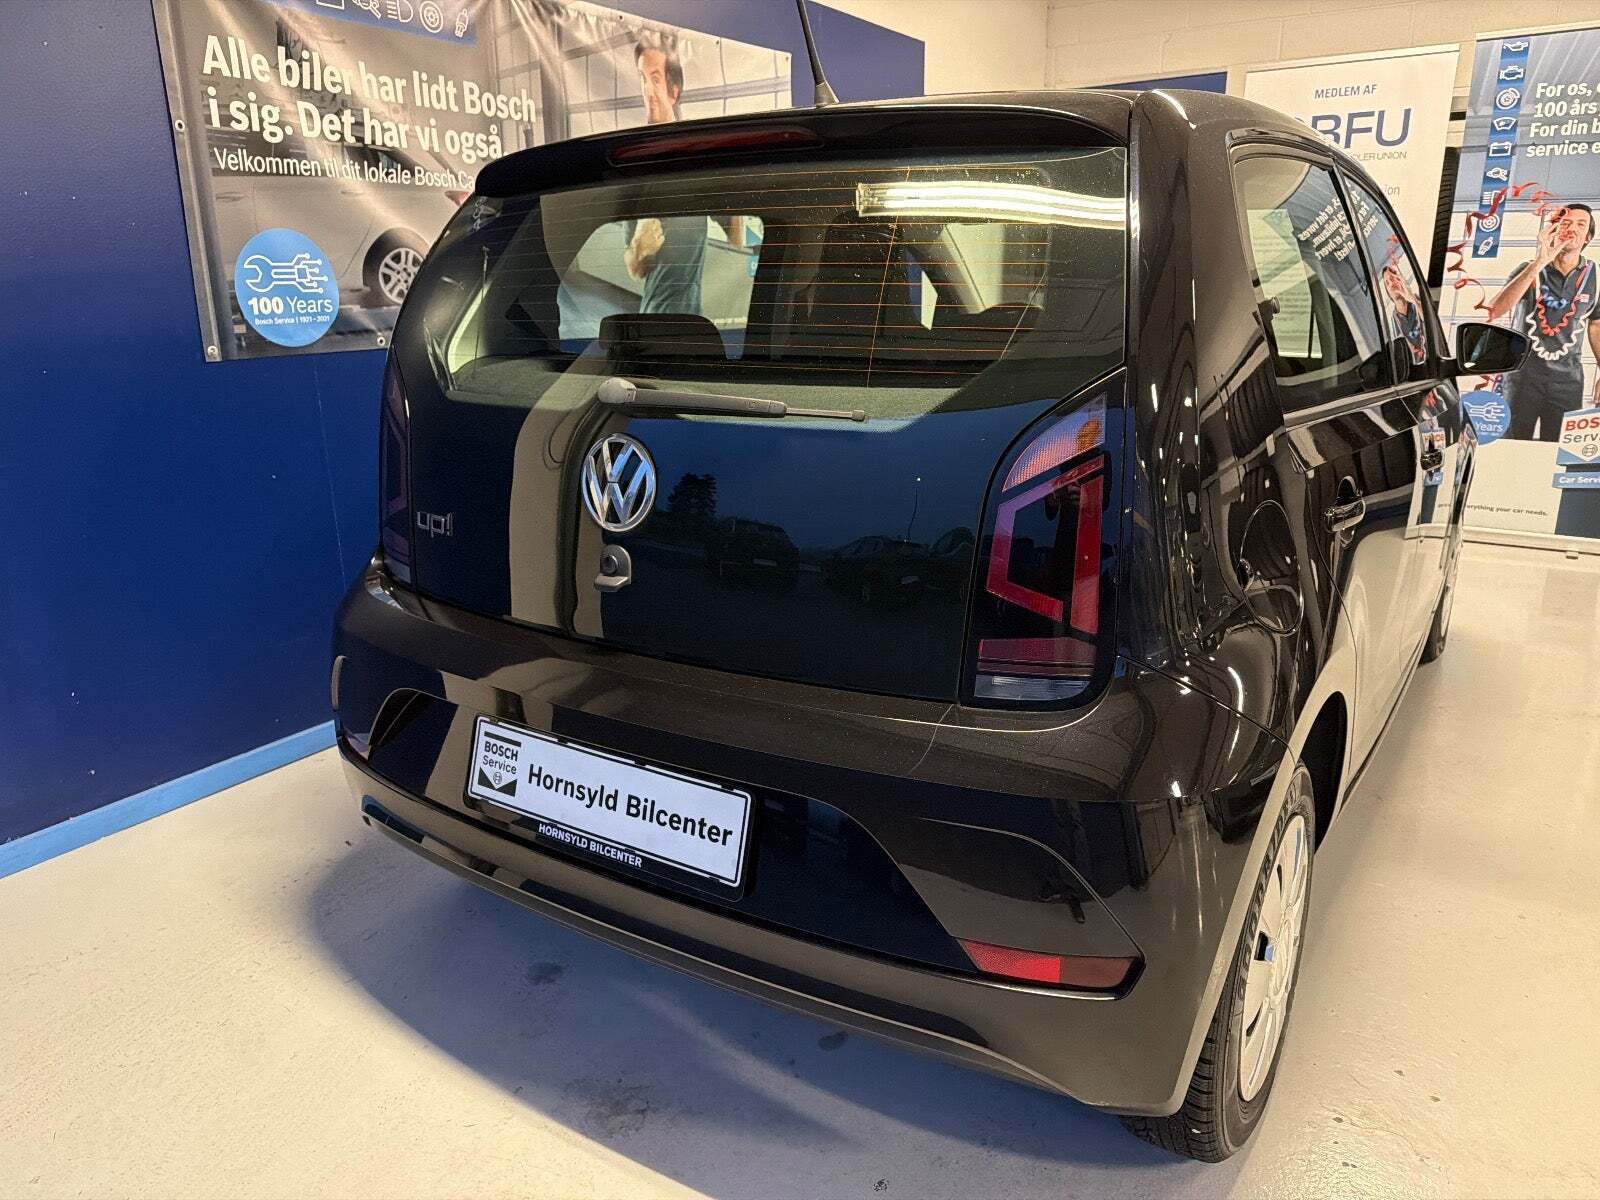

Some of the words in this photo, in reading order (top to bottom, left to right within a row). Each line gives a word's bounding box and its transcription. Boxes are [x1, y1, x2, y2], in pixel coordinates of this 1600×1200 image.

[203, 35, 271, 83] Alle
[277, 46, 352, 96] biler
[358, 61, 407, 105] har
[412, 70, 459, 113] lidt
[462, 80, 536, 123] Bosch
[1314, 86, 1360, 99] MEDLEM
[1363, 84, 1377, 95] AF
[1535, 82, 1565, 98] For
[1567, 82, 1593, 97] os,
[1533, 101, 1568, 118] 100
[1569, 98, 1598, 116] års
[207, 86, 220, 128] i
[229, 91, 294, 144] sig.
[297, 100, 356, 144] Det
[363, 107, 410, 149] har
[414, 118, 440, 153] vi
[1530, 122, 1560, 138] For
[1561, 119, 1588, 136] din
[1526, 140, 1589, 158] service
[213, 147, 322, 177] Velkommen
[324, 157, 340, 178] til
[342, 160, 362, 181] dit
[364, 160, 411, 185] lokale
[414, 166, 457, 188] Bosch
[458, 171, 475, 189] Ca
[248, 297, 284, 315] 100
[286, 296, 333, 314] Years
[1565, 416, 1600, 431] BOS
[1562, 432, 1600, 444] Serv
[416, 511, 453, 538] up!
[484, 741, 519, 762] BOSCH
[482, 755, 517, 775] Service
[528, 763, 619, 812] Hornsyld
[626, 793, 733, 846] Bilcenter
[538, 823, 588, 849] HORNSYLD
[589, 841, 643, 868] BILCENTER
